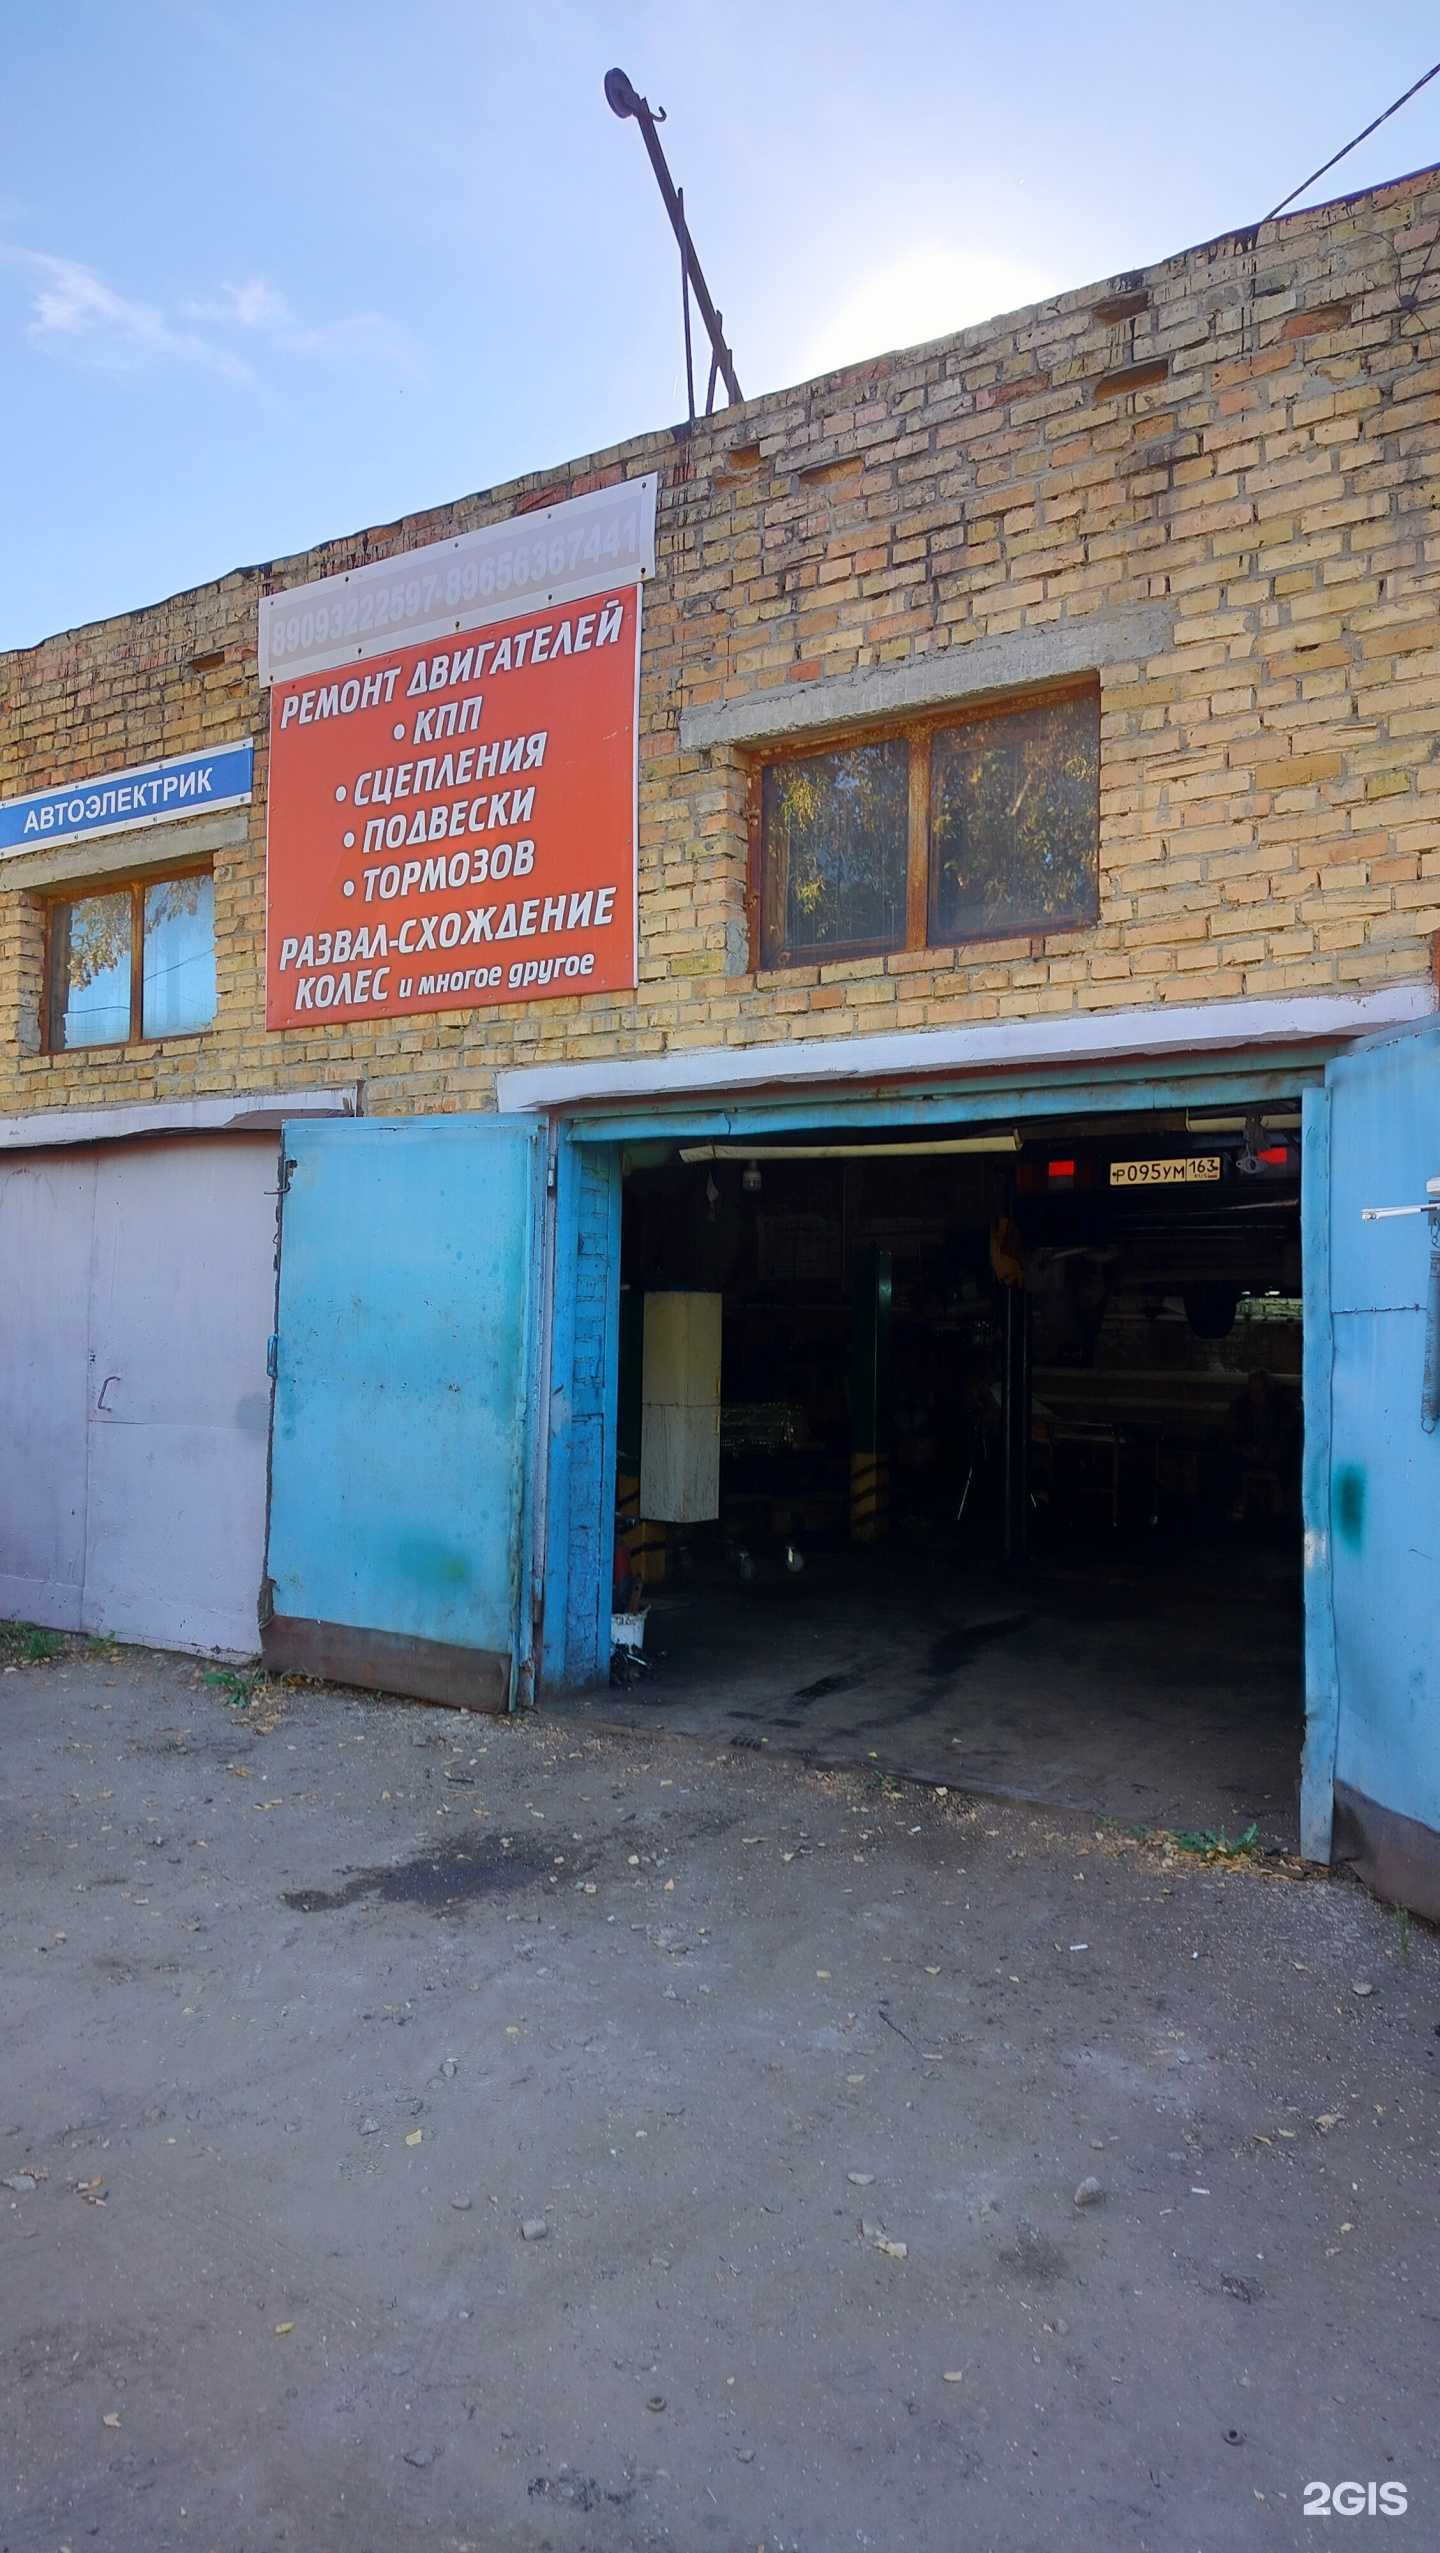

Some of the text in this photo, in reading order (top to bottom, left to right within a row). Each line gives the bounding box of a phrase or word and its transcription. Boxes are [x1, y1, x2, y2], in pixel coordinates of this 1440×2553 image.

[280, 600, 624, 729] РЕМОНТ ДВИГАТЕЛЕЙ
[413, 696, 483, 745] КПП
[23, 767, 214, 834] АВТОЭЛЕКТРИК
[354, 731, 548, 806] СЦЕПЛЕНИЯ
[362, 786, 536, 854] ПОДВЕСКИ
[363, 839, 535, 902] ТОРМОЗОВ
[279, 886, 618, 971] РАЗВАЛ-СХОЖДЕНИЕ
[295, 952, 595, 1011] КОЛЕС и многое другое
[1188, 1159, 1215, 1174] 163
